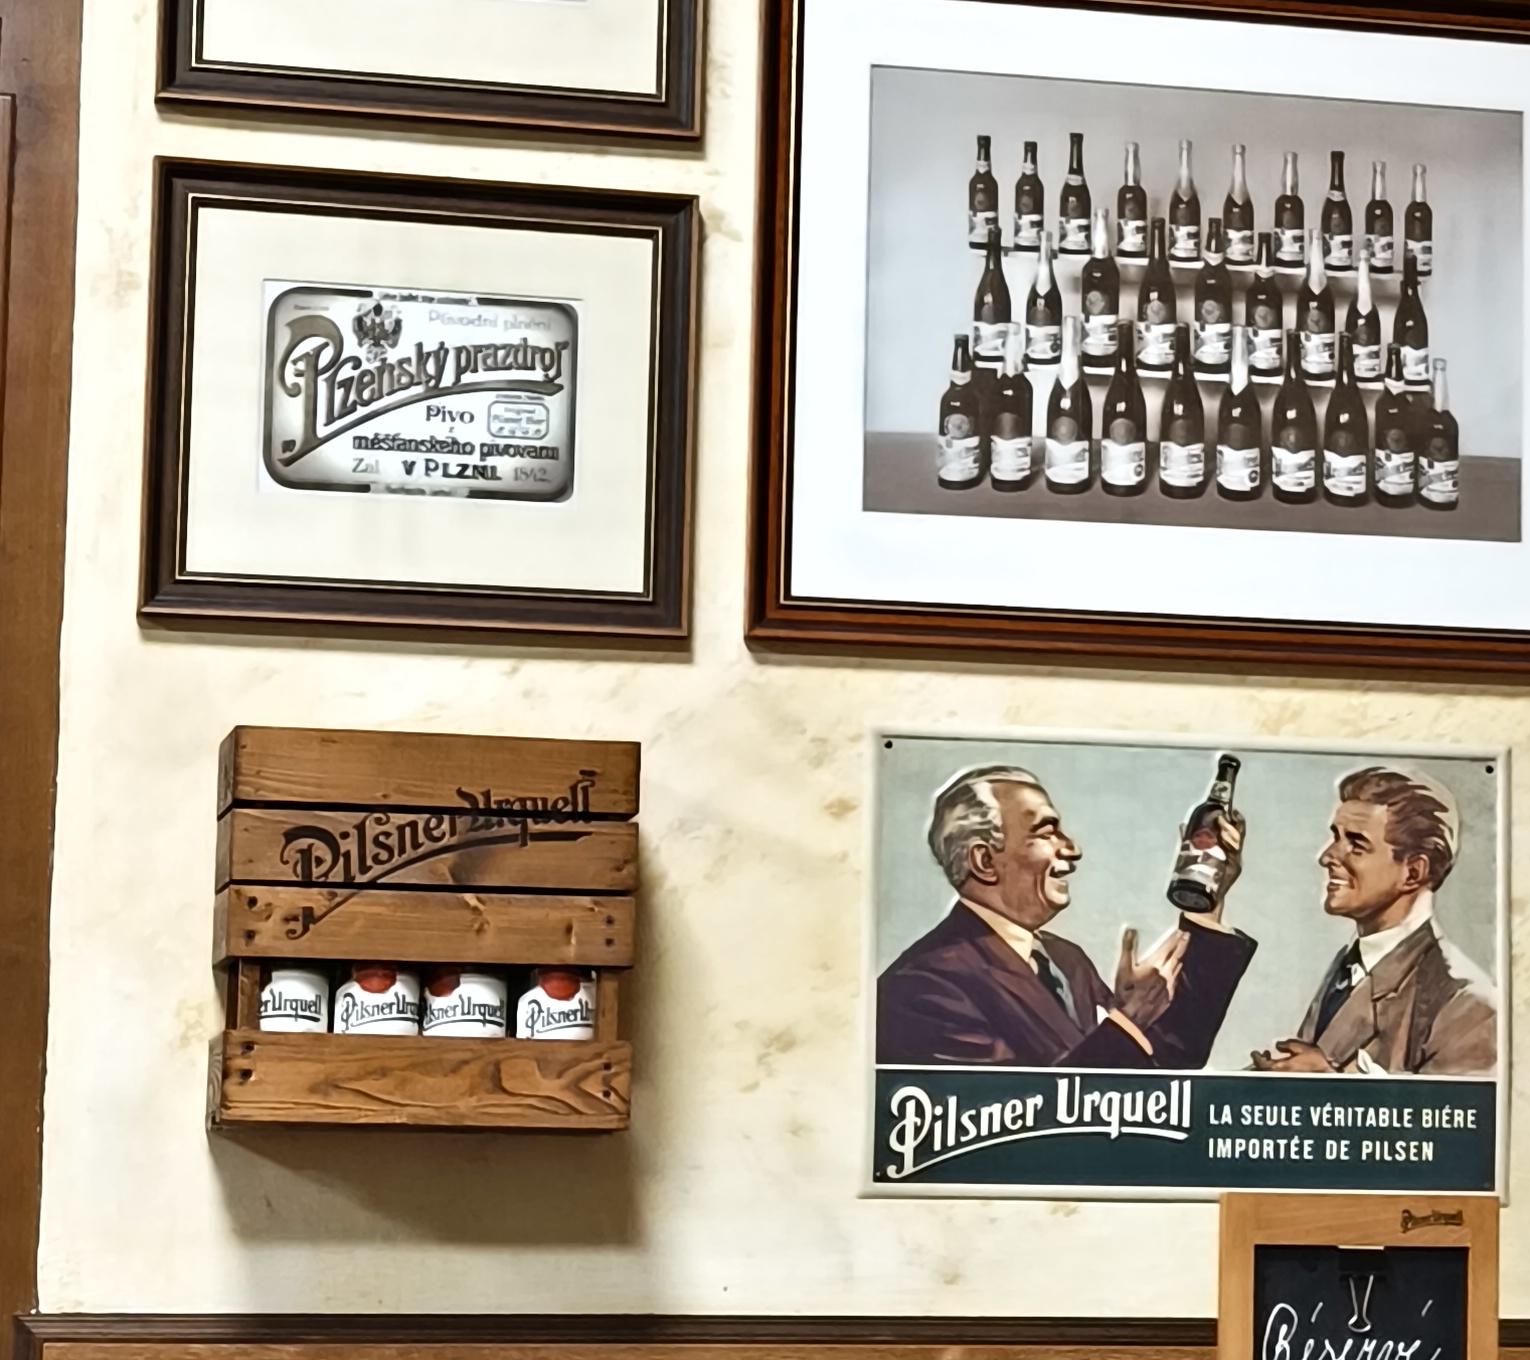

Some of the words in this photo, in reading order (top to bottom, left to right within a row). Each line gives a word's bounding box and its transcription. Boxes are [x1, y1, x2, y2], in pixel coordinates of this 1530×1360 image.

[425, 404, 475, 425] Pivo
[279, 811, 458, 940] Pilsner
[456, 770, 598, 847] Urquell
[270, 988, 322, 1022] Urquell
[340, 992, 395, 1032] Pilsner
[887, 1086, 1043, 1179] Pilsner
[1055, 1077, 1191, 1139] Urquell
[1210, 1104, 1232, 1126] LA
[1241, 1104, 1302, 1127] SEULE
[1310, 1101, 1412, 1129] VÉRITABLE
[1208, 1136, 1314, 1161] IMPORTÉE
[1326, 1140, 1349, 1161] DE
[1361, 1140, 1434, 1162] PILSEN
